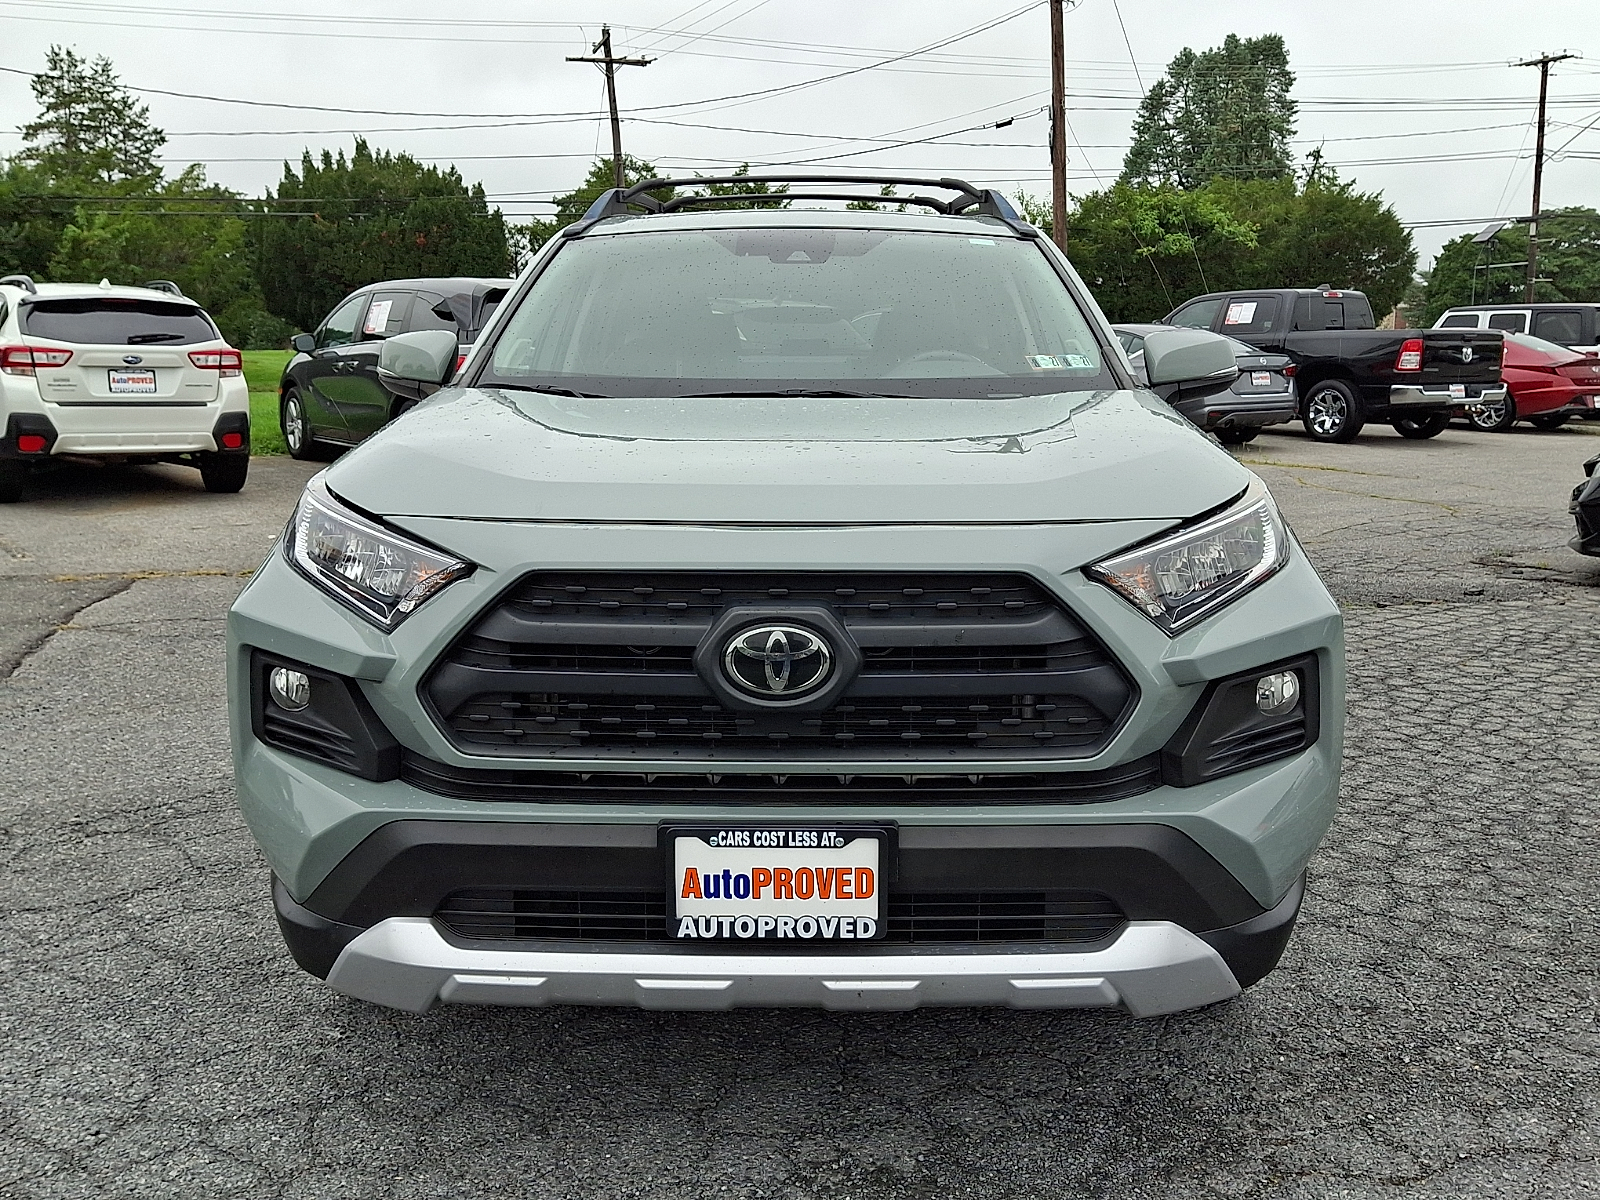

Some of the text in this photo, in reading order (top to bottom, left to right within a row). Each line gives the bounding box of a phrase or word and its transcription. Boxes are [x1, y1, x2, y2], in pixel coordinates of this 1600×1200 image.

[718, 831, 836, 847] CARS COST LESS AT
[681, 867, 875, 900] AutoPROVED
[677, 915, 877, 939] AUTOPROVED
